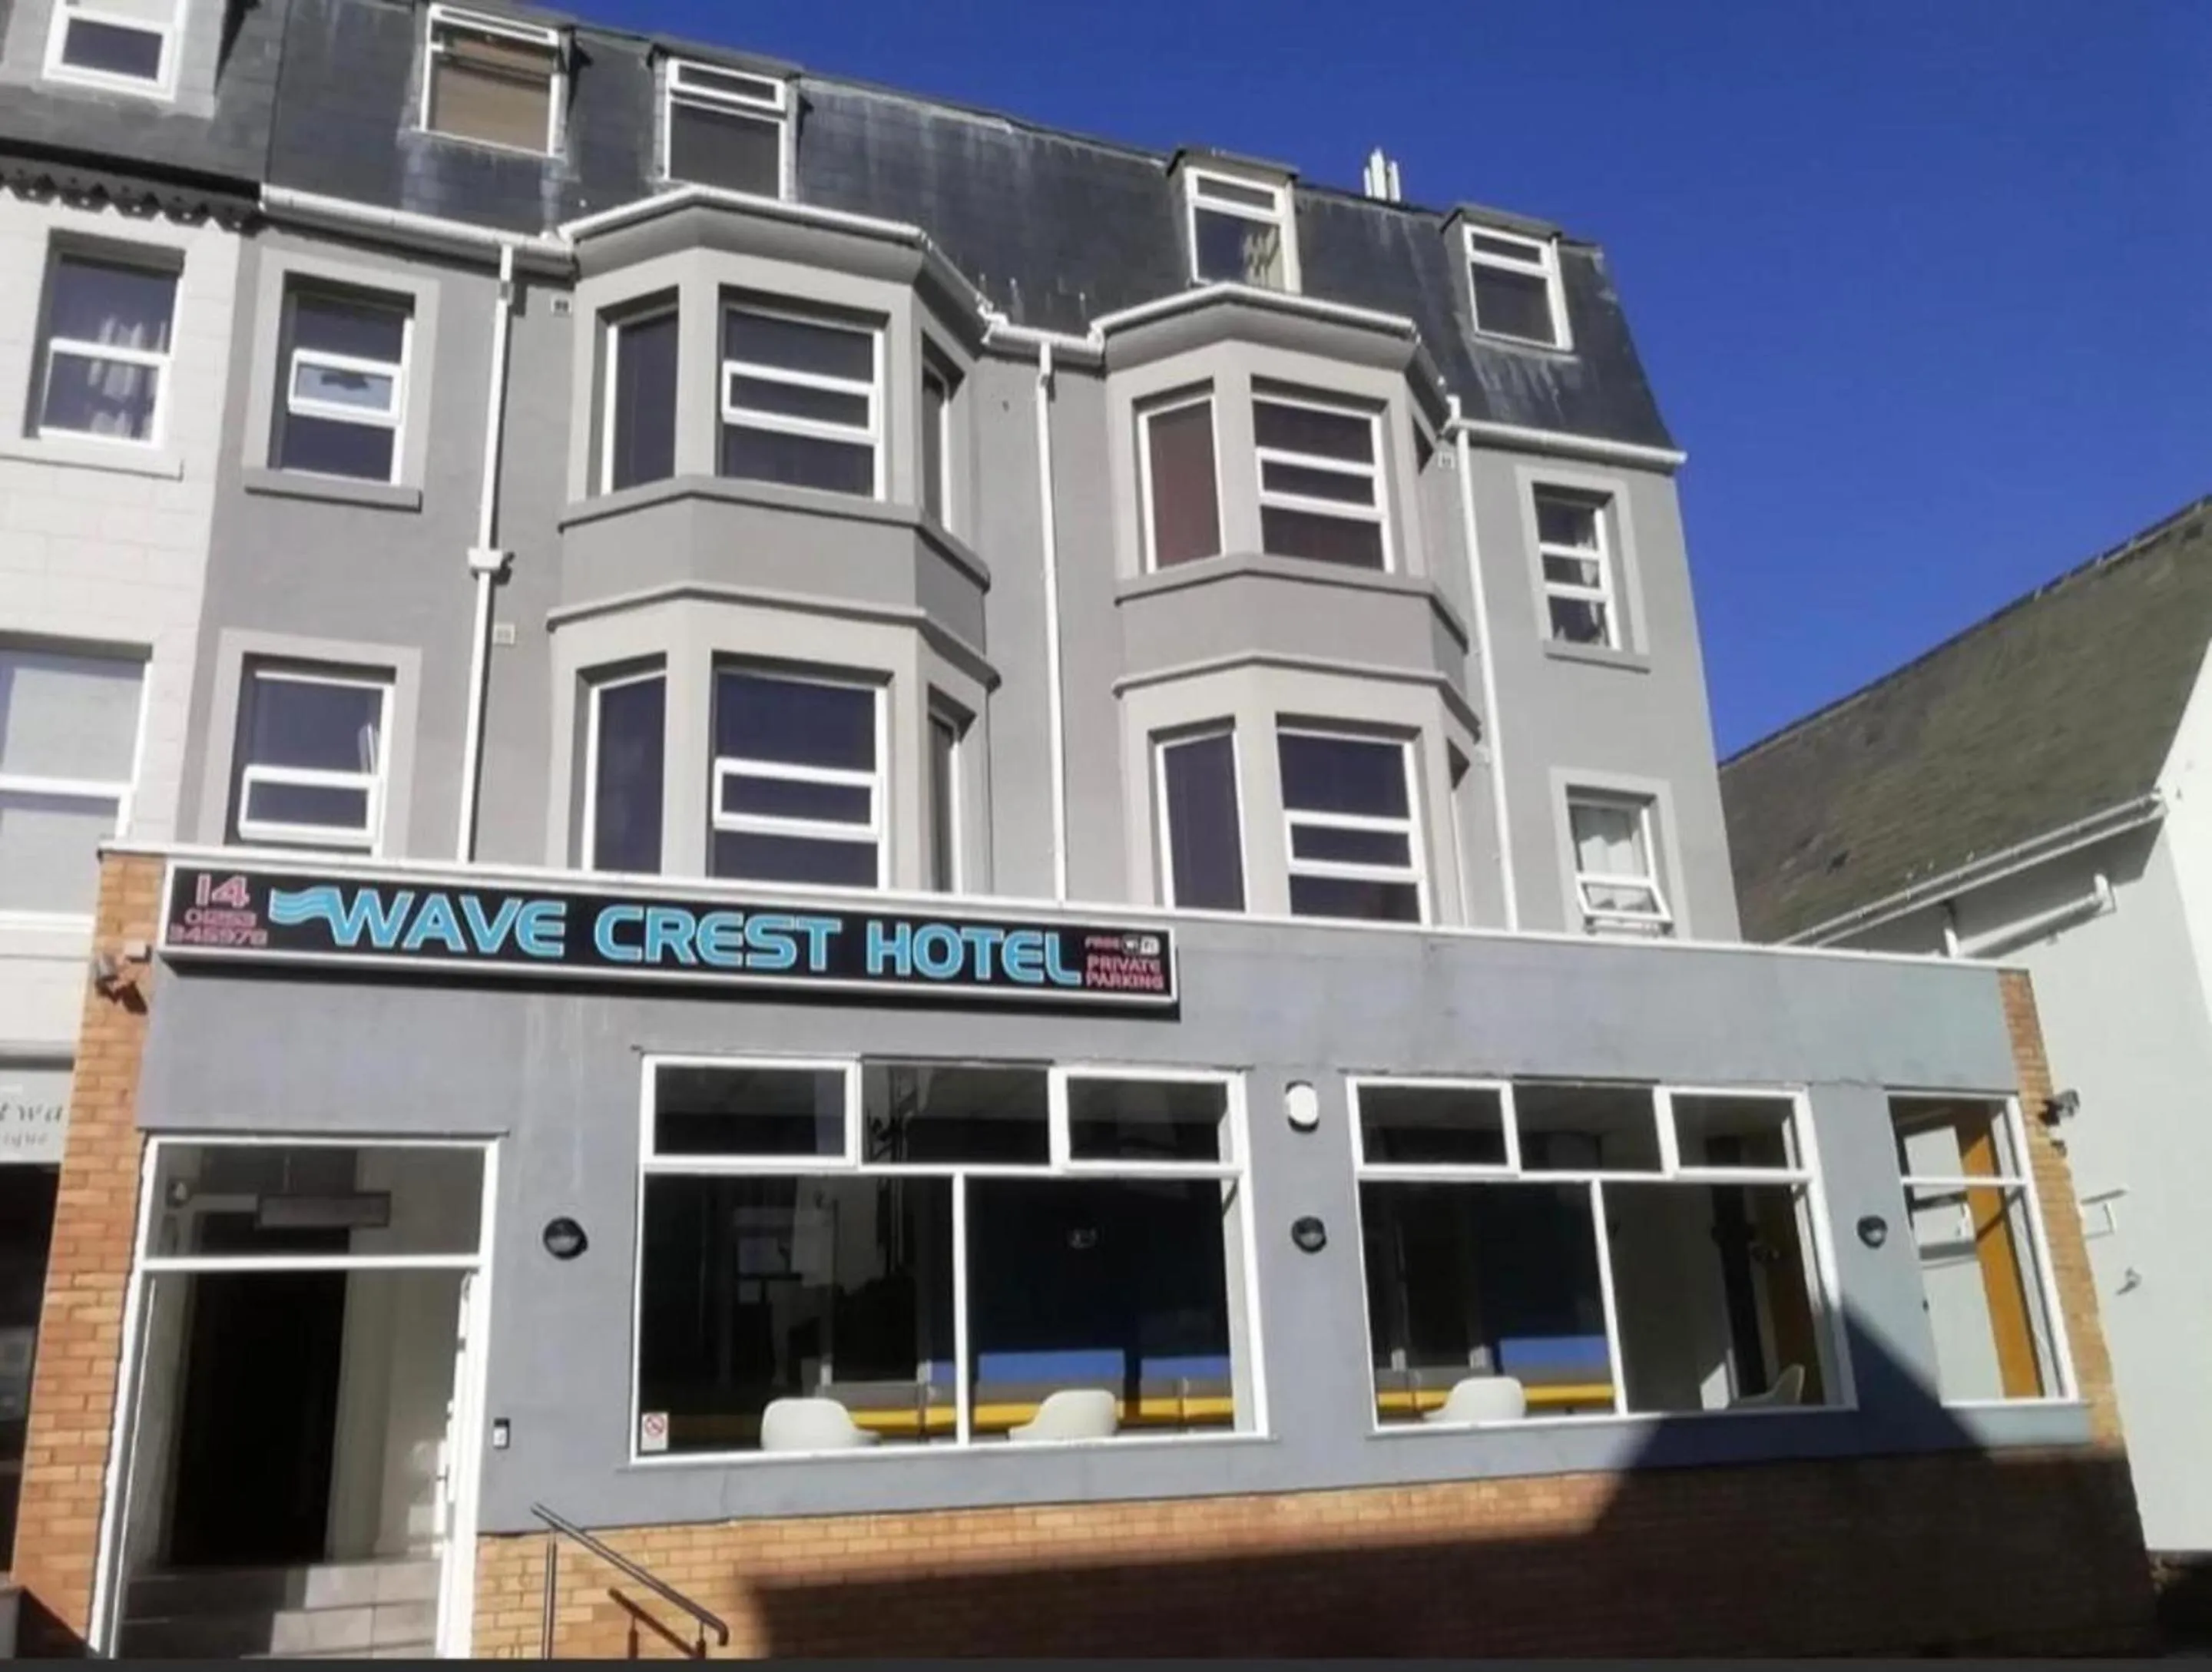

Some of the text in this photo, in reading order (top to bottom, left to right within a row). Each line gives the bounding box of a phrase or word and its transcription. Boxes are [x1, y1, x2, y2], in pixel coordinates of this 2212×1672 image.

[195, 872, 250, 908] 14
[323, 885, 1082, 985] WAVE CREST HOTEL
[1087, 953, 1161, 975] PRIVATE
[1086, 970, 1164, 991] PARKING
